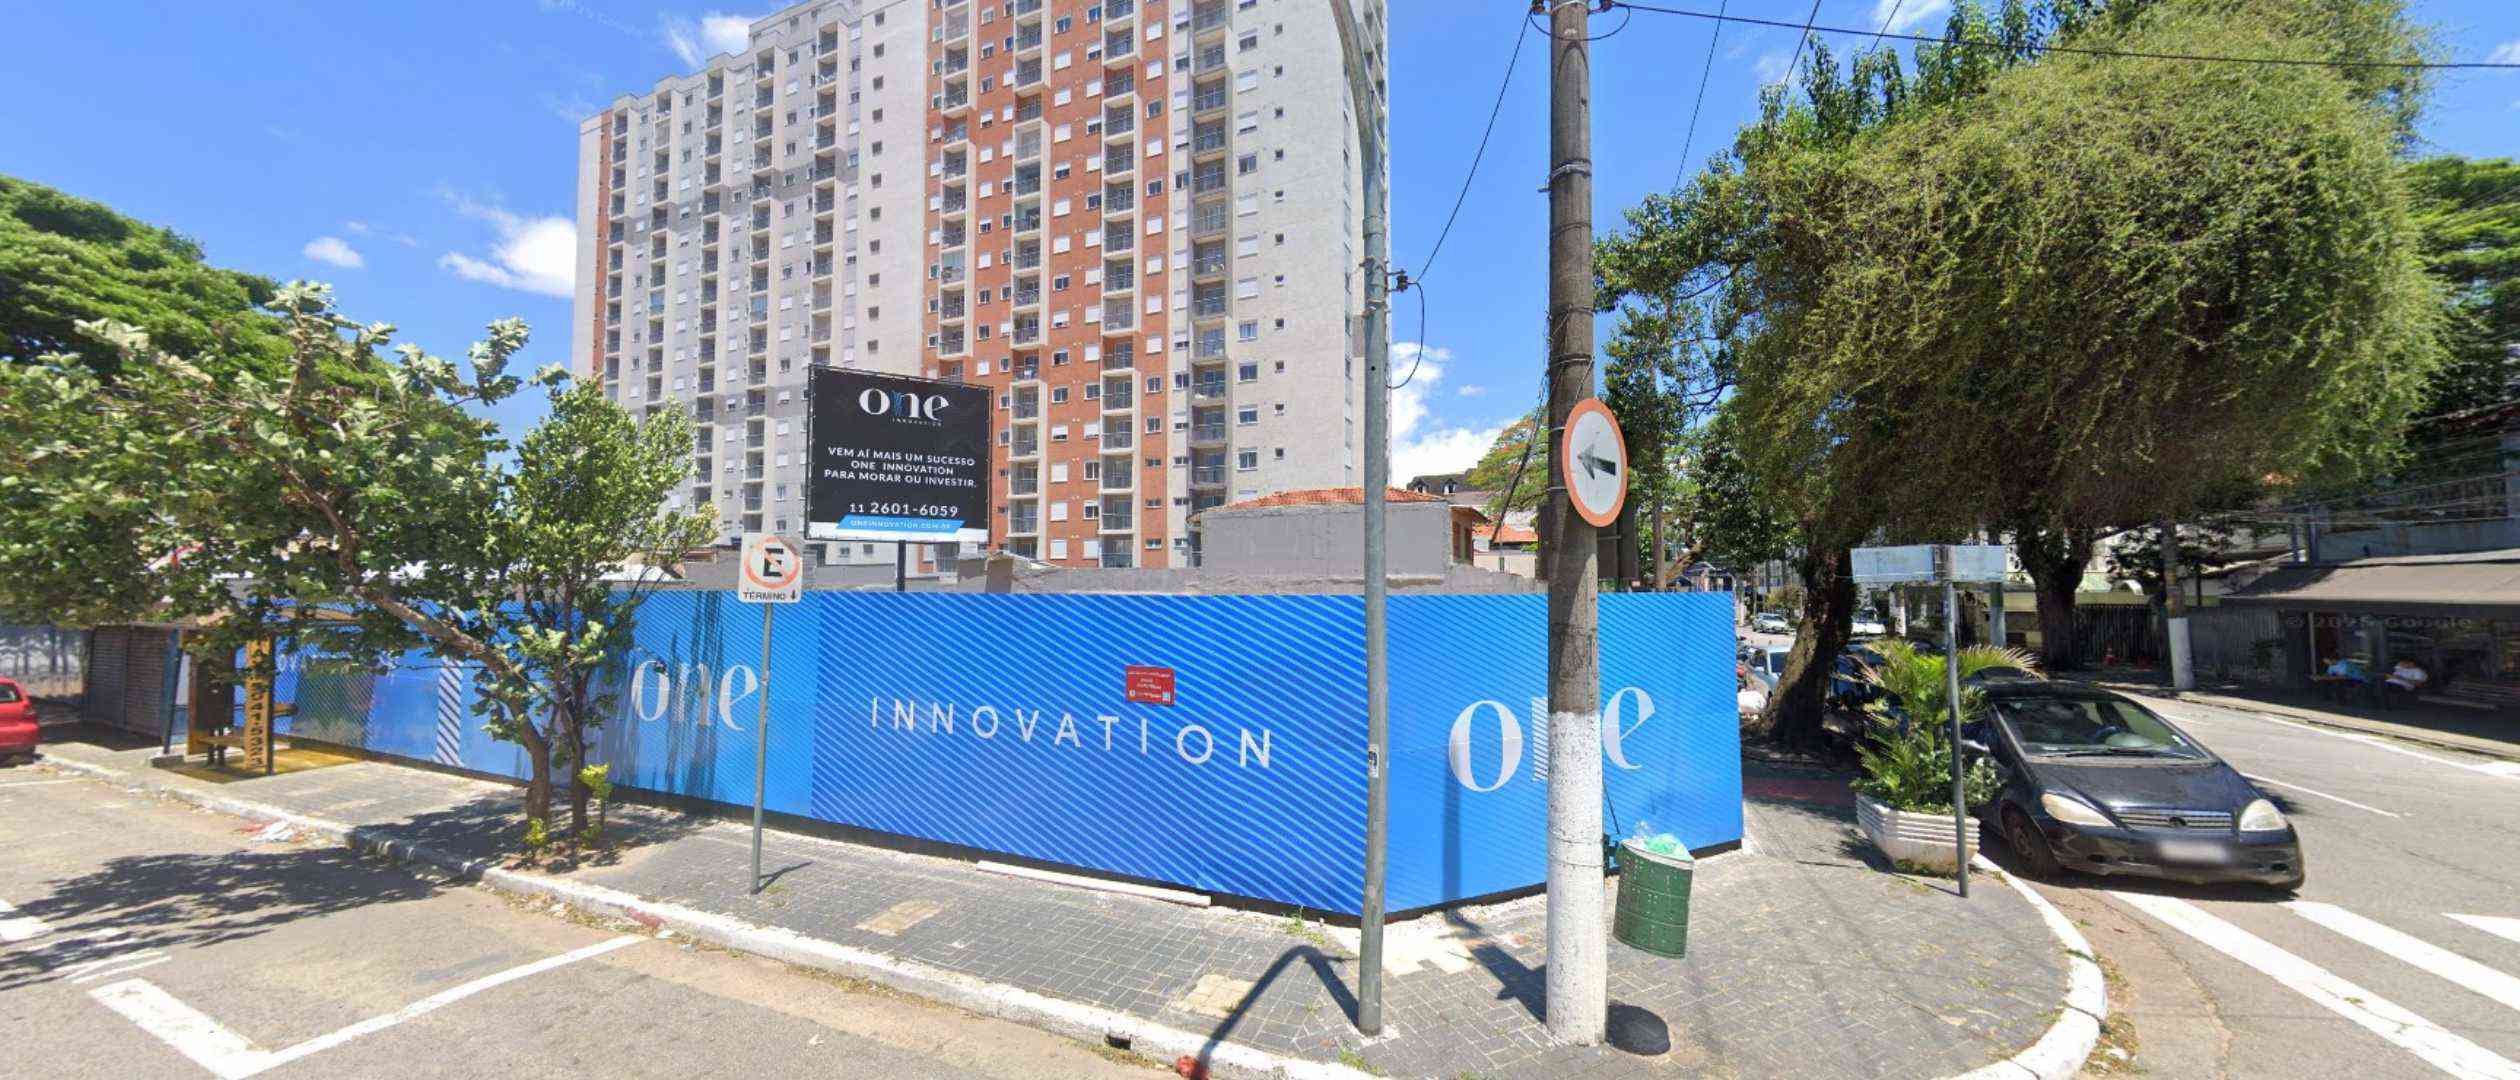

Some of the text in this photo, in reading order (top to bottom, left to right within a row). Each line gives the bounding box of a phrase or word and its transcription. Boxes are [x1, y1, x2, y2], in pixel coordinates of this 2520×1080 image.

[859, 388, 949, 421] one
[828, 447, 854, 458] VEM
[873, 450, 902, 461] MAIS
[905, 452, 923, 462] UM
[927, 454, 976, 467] SUCESSO
[851, 460, 954, 476] ONE INNOVATION
[824, 469, 977, 488] PARA MORAR OU INVESTIR.
[849, 502, 958, 518] 11 2601-6059
[763, 547, 784, 577] E
[631, 660, 758, 732] one
[872, 696, 1271, 768] INNOVATION
[1449, 686, 1656, 792] oe
